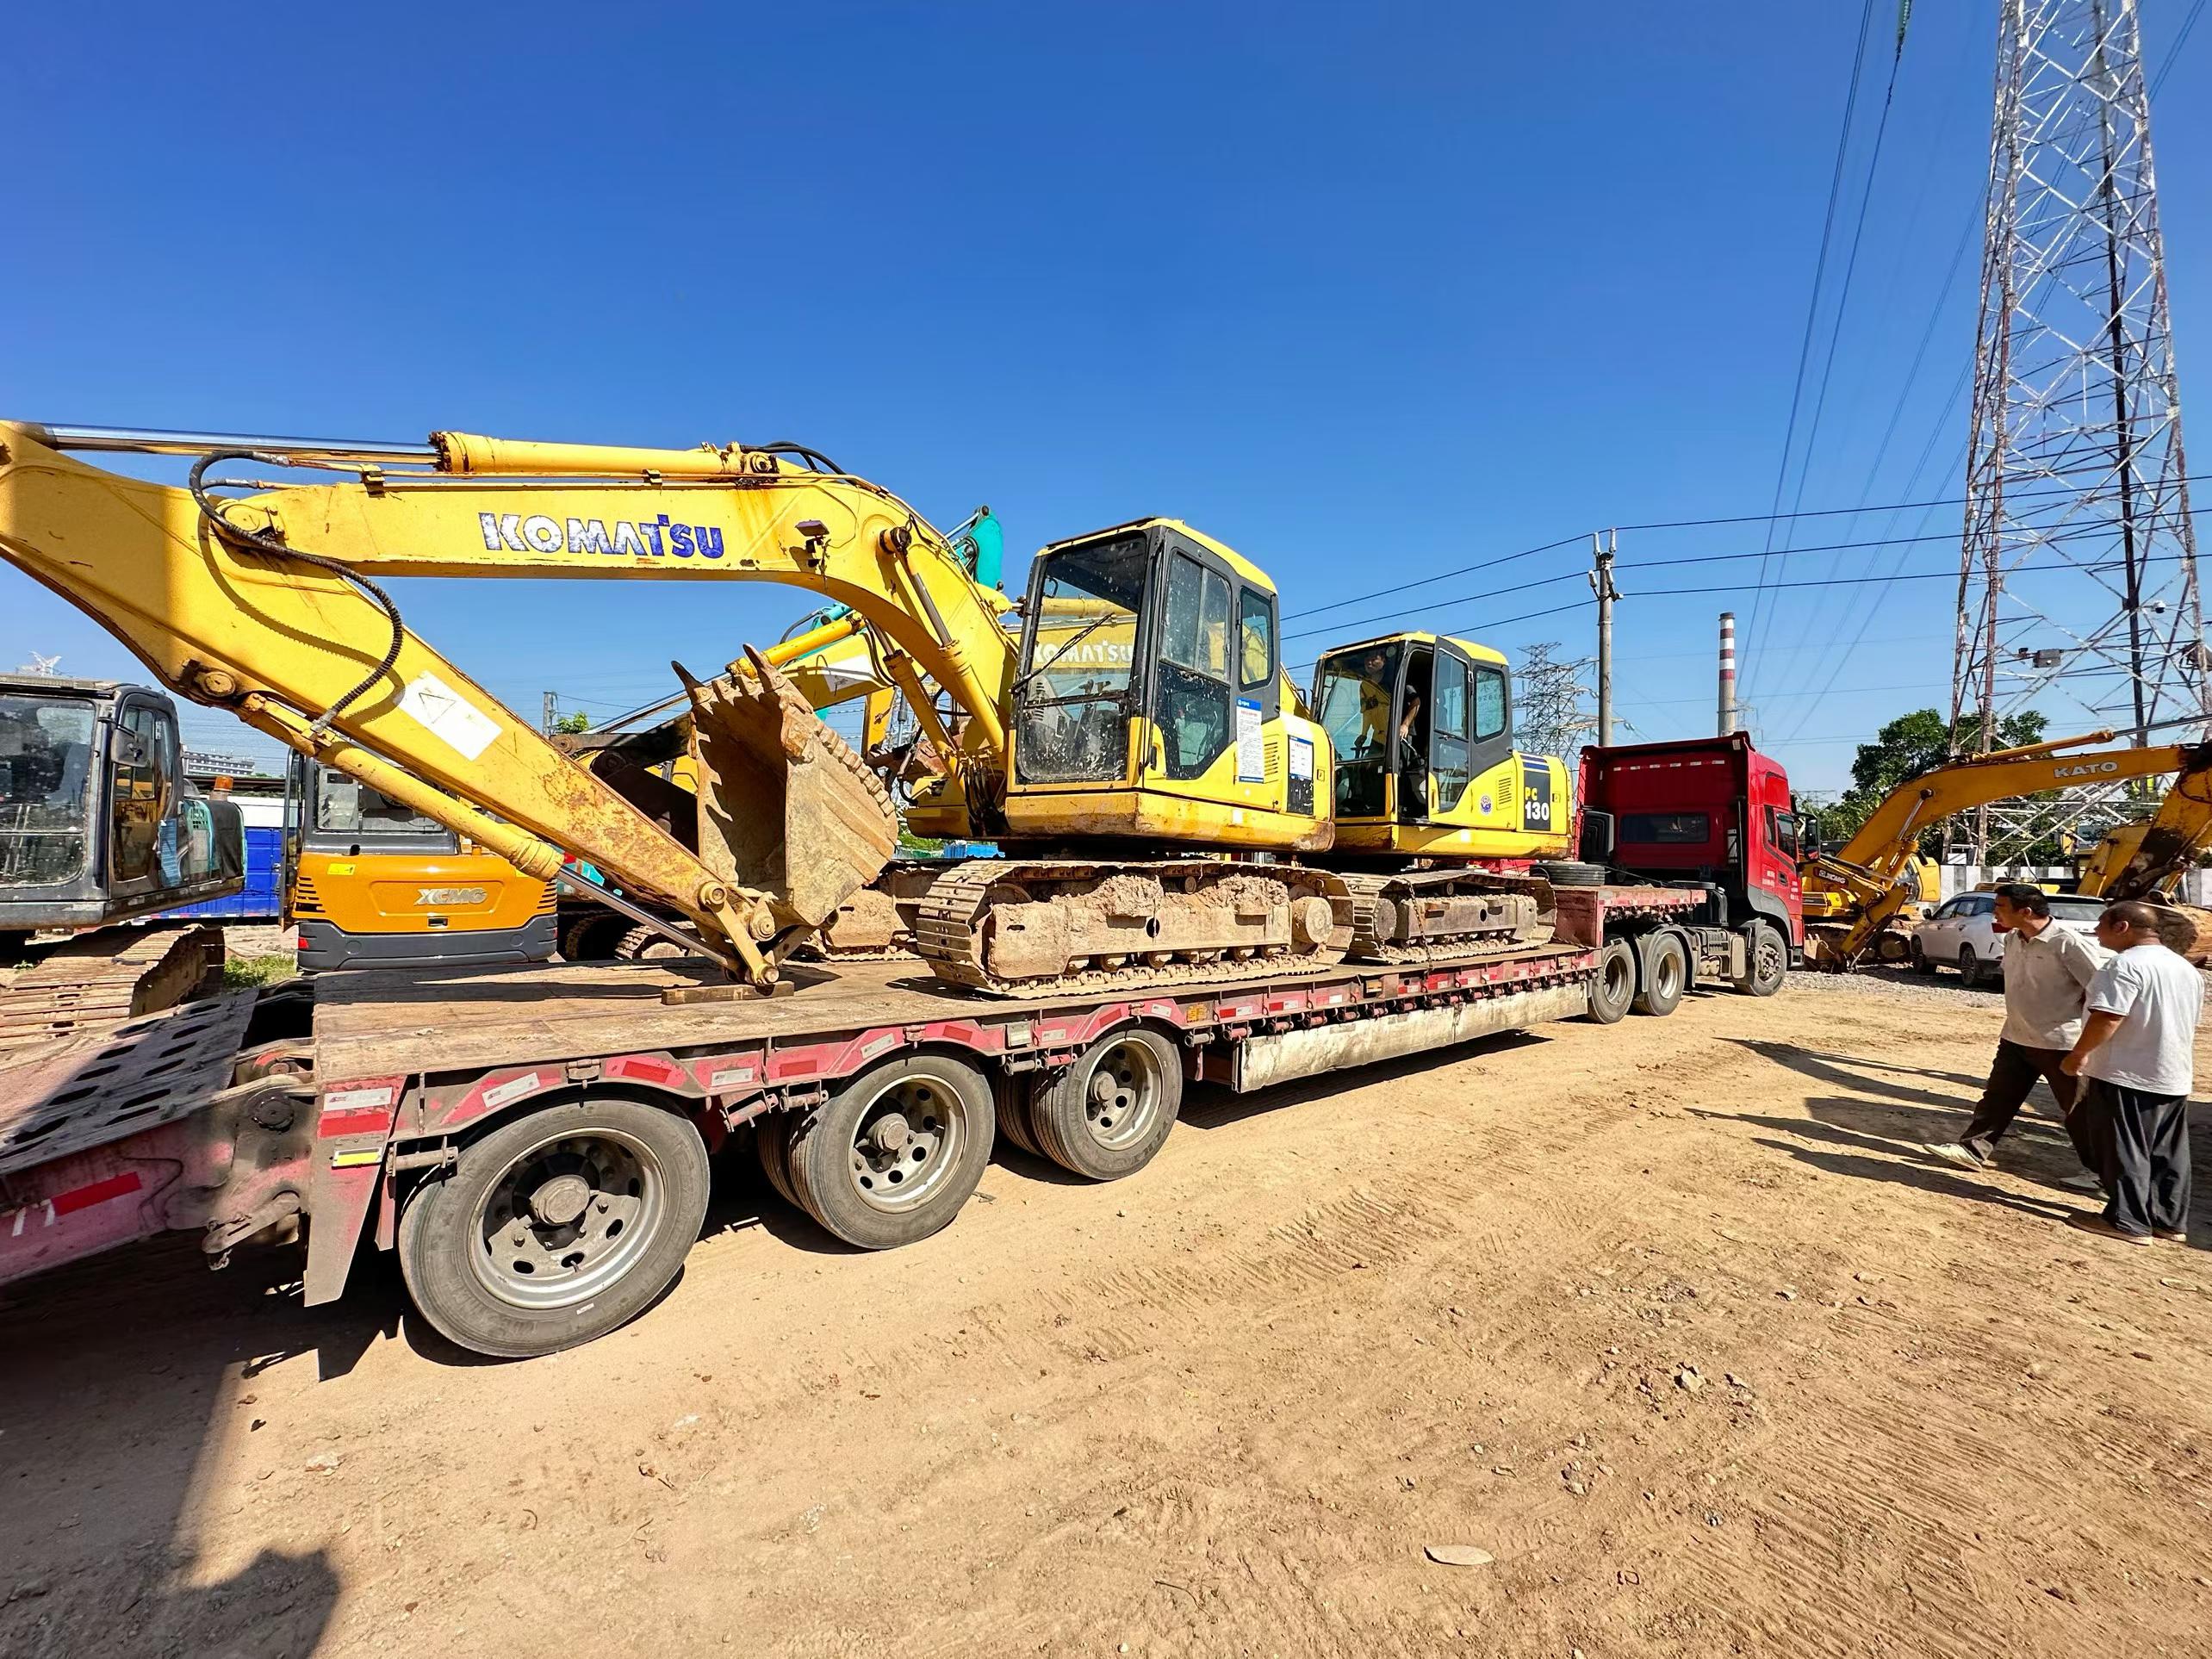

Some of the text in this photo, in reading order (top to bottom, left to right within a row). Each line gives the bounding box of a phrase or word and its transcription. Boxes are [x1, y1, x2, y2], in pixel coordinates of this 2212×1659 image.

[478, 513, 724, 559] KOMATSU
[2054, 761, 2118, 779] KATO
[1525, 787, 1538, 801] PC
[1525, 801, 1550, 821] 130
[413, 888, 488, 905] XCMG
